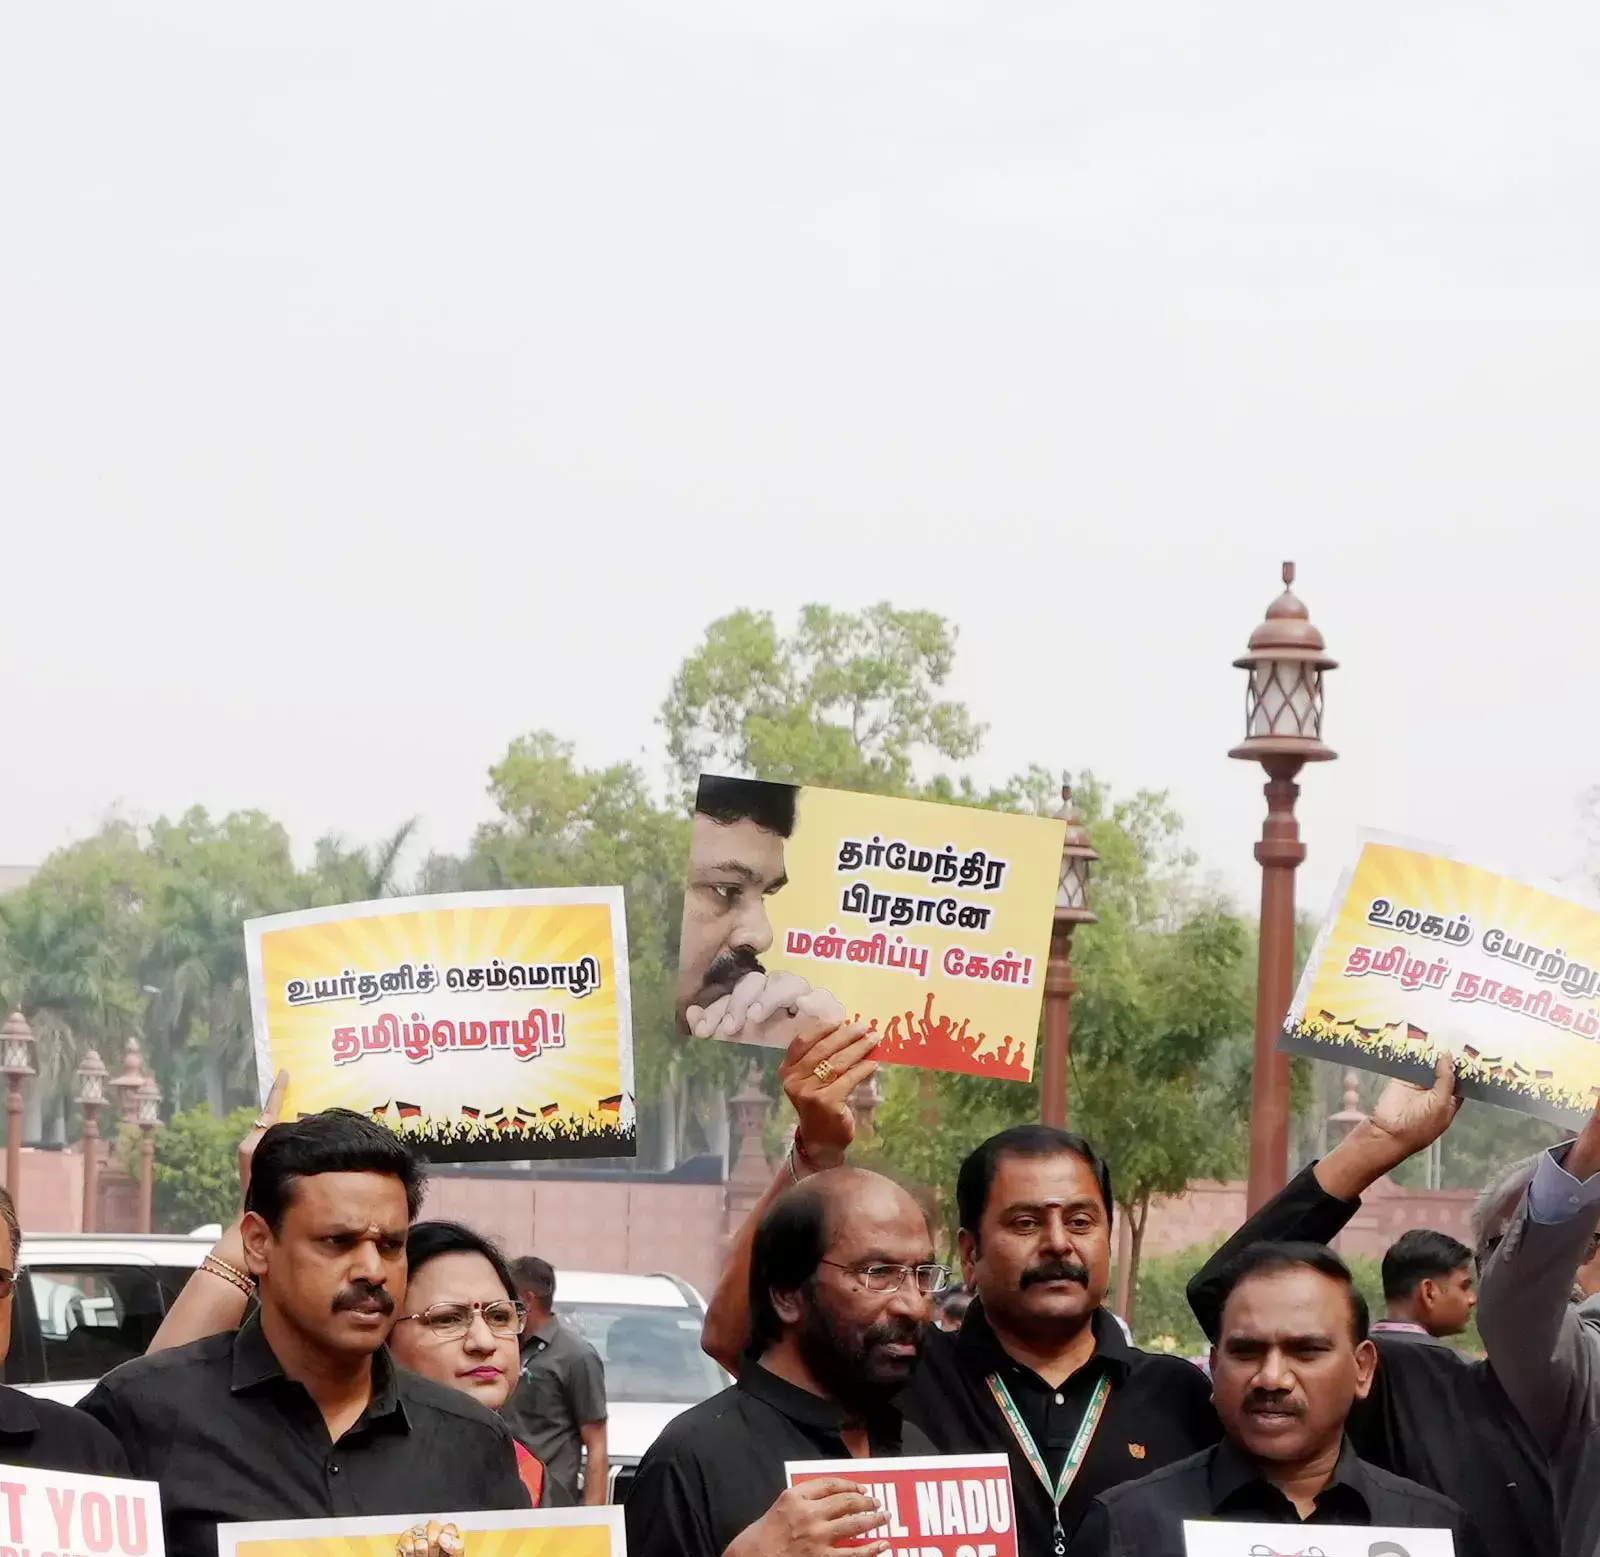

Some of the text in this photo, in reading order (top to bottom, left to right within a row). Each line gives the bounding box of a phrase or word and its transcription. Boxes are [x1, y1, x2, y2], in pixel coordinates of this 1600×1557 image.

[839, 836, 1006, 890] தர்மேந்திர
[842, 883, 992, 930] பிரதானே
[1368, 899, 1469, 943] உலகம்
[287, 958, 596, 1003] உயர்தனிச் செம்மொழி
[786, 927, 1032, 984] மன்னிப்பு கேள்!
[1345, 944, 1449, 990] தமிழர்
[332, 1008, 563, 1060] தமிழ்மொழி!
[45, 1487, 148, 1557] YOU
[915, 1478, 1011, 1538] NADU
